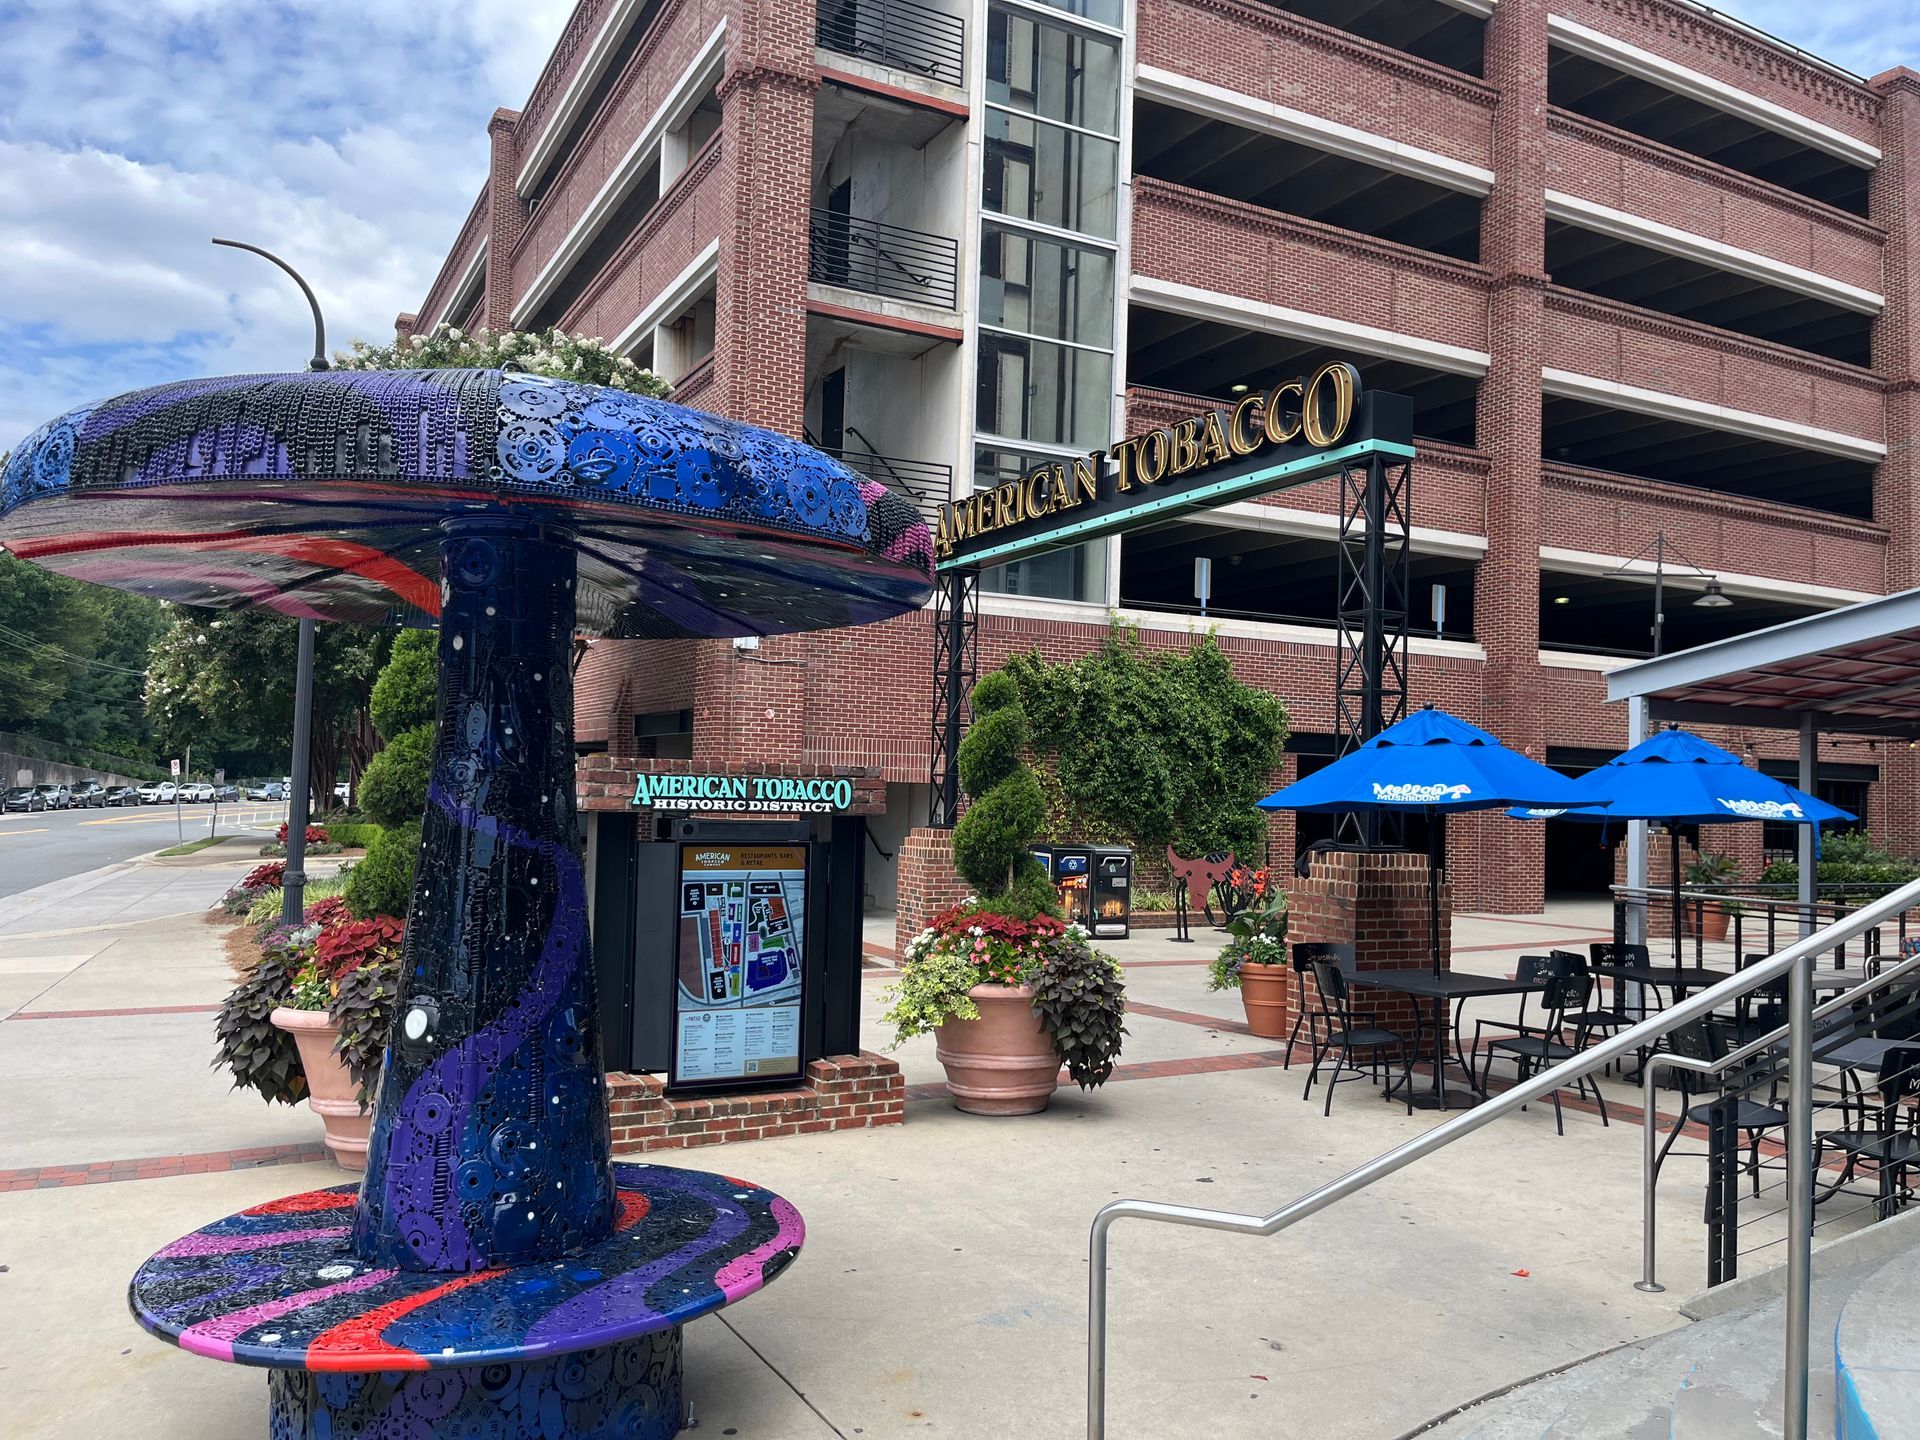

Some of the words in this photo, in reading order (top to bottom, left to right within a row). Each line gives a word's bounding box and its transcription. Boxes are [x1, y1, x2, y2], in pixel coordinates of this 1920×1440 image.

[934, 451, 1105, 558] AMERICAN
[1111, 360, 1362, 492] TOBACCO
[632, 773, 747, 805] AMERICAN
[753, 778, 851, 809] TOBACCO
[1372, 783, 1448, 796] Mellow
[1377, 793, 1440, 802] MUSHROOM
[653, 799, 746, 811] HISTORIC
[748, 801, 834, 813] DISTRICT
[695, 852, 731, 862] AMERICAN
